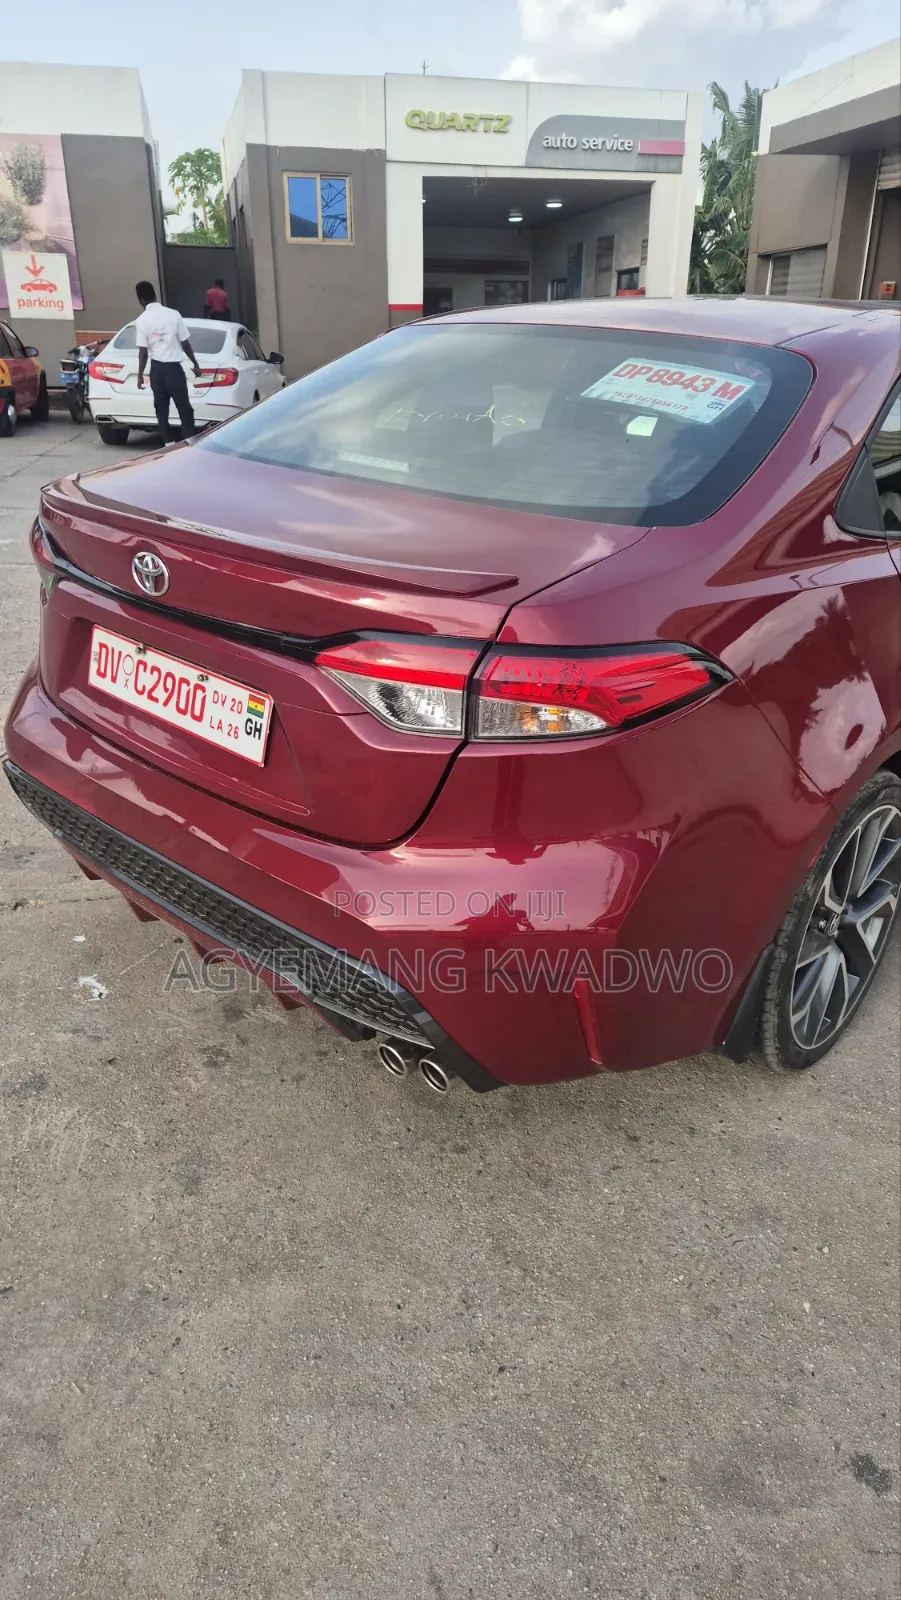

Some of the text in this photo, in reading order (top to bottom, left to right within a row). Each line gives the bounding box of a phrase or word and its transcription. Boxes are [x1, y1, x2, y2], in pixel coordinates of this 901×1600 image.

[405, 109, 511, 133] QUARTZ
[542, 132, 634, 151] auto service
[17, 296, 65, 311] parking
[612, 363, 746, 400] DP 8943 M
[706, 403, 725, 412] GH
[96, 641, 207, 723] DV C2900
[212, 690, 243, 715] DV 20
[209, 716, 240, 740] LA 26
[244, 718, 263, 741] GH
